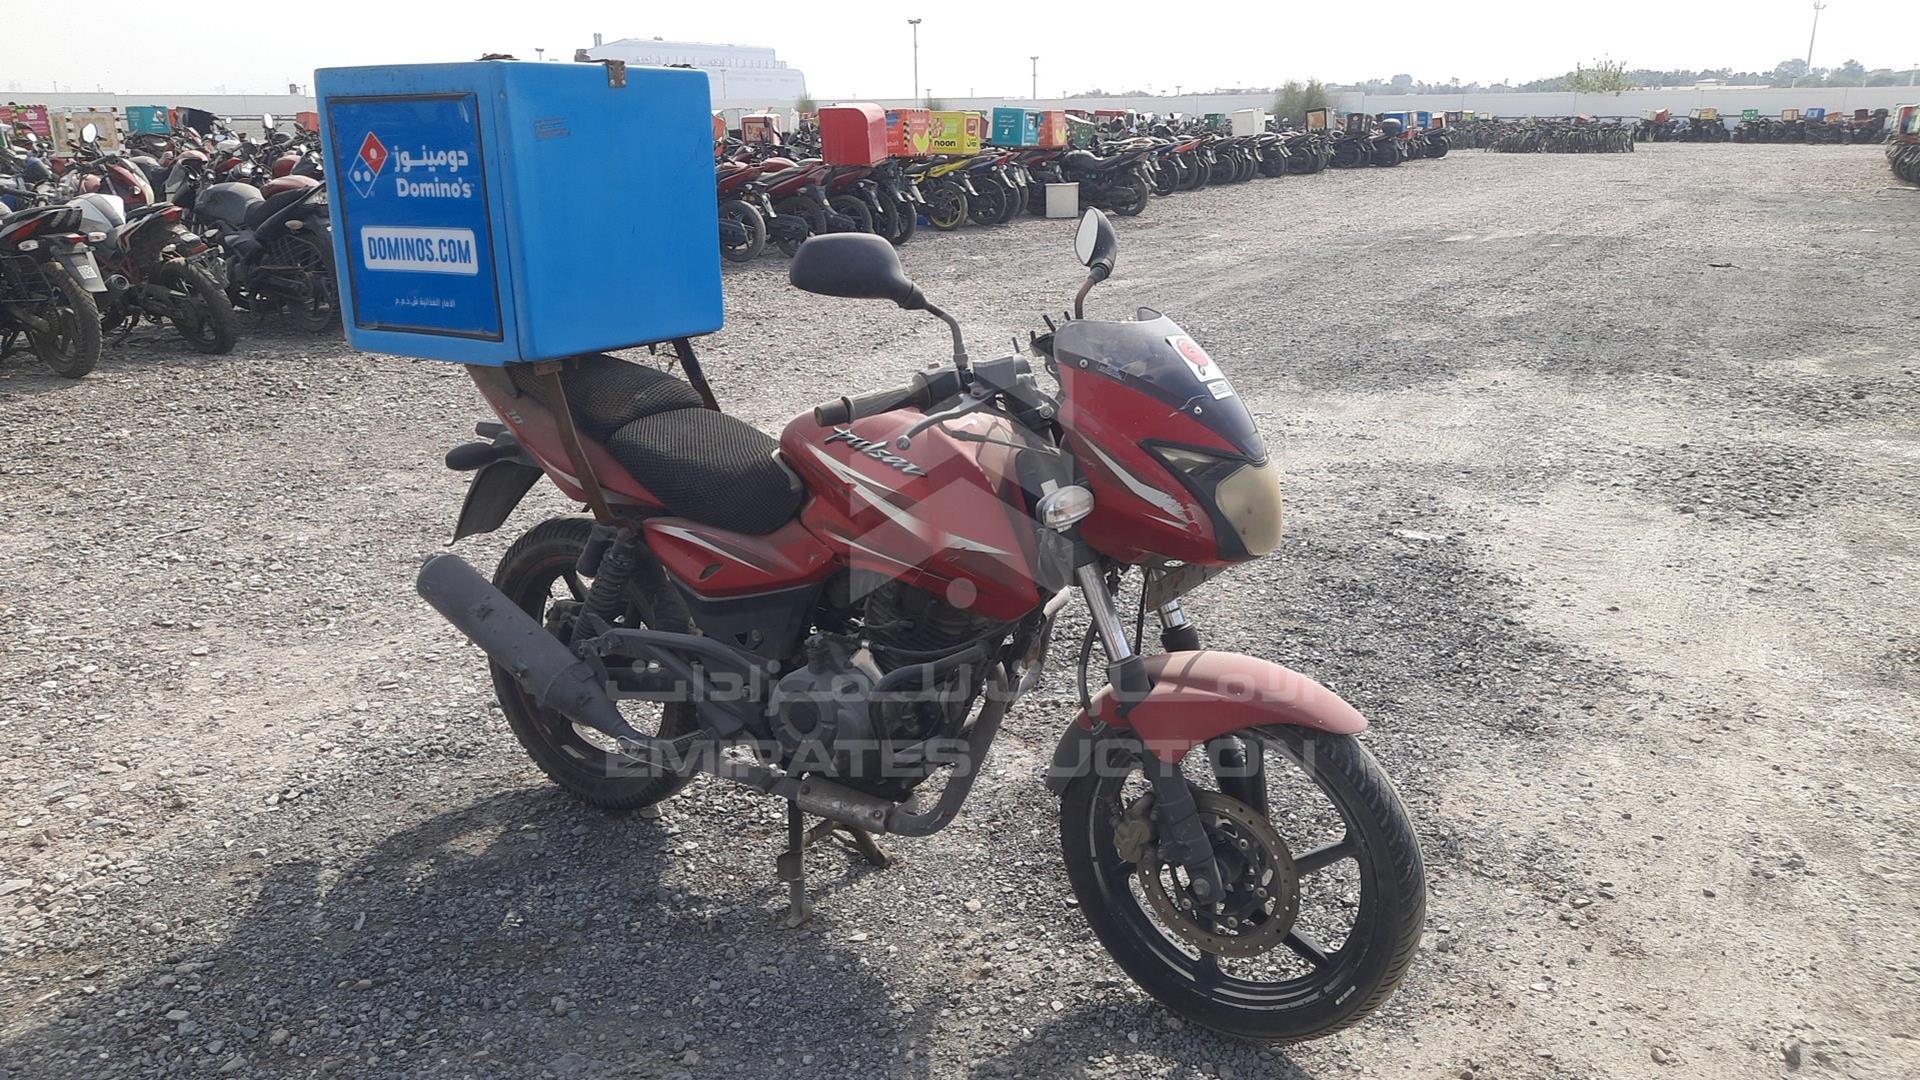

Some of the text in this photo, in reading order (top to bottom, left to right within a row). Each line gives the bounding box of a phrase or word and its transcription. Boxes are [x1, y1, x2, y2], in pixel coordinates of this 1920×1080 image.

[393, 145, 469, 172] دومينوز
[396, 177, 472, 198] Domino's
[367, 236, 472, 264] DOMINOS.COM
